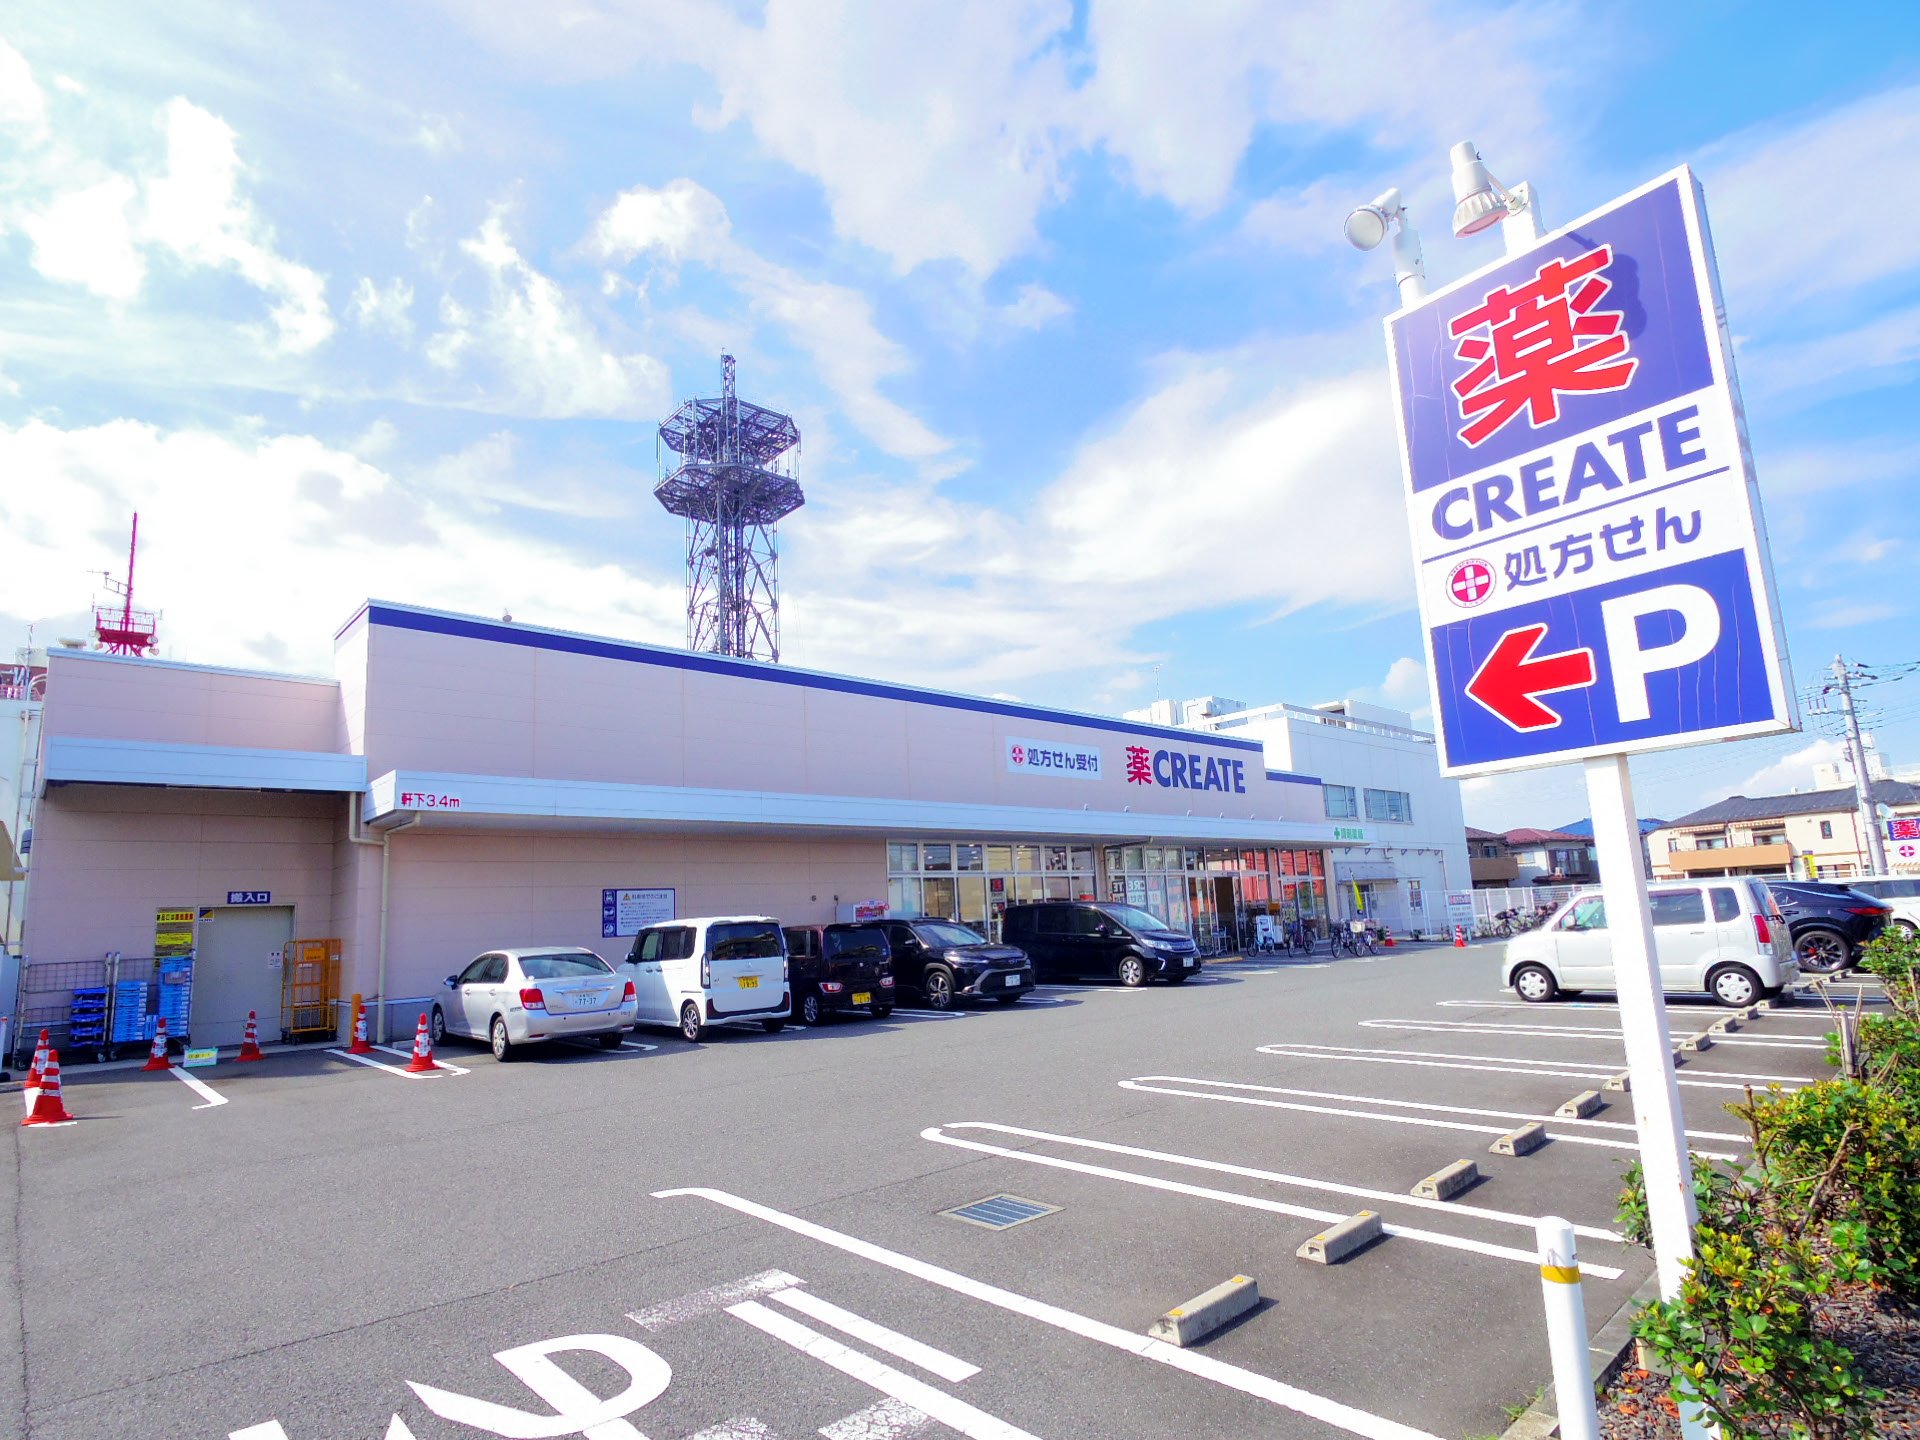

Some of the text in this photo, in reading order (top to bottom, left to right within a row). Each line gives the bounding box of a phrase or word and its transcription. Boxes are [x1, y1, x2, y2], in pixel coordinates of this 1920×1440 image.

[1449, 246, 1638, 446] 薬
[1431, 404, 1707, 541] CREATE
[1503, 506, 1702, 591] 処方せん
[1601, 583, 1720, 723] P
[401, 792, 460, 807] 軒下3.4m
[1027, 748, 1098, 772] 処方せん受付
[1153, 749, 1246, 793] CREATE
